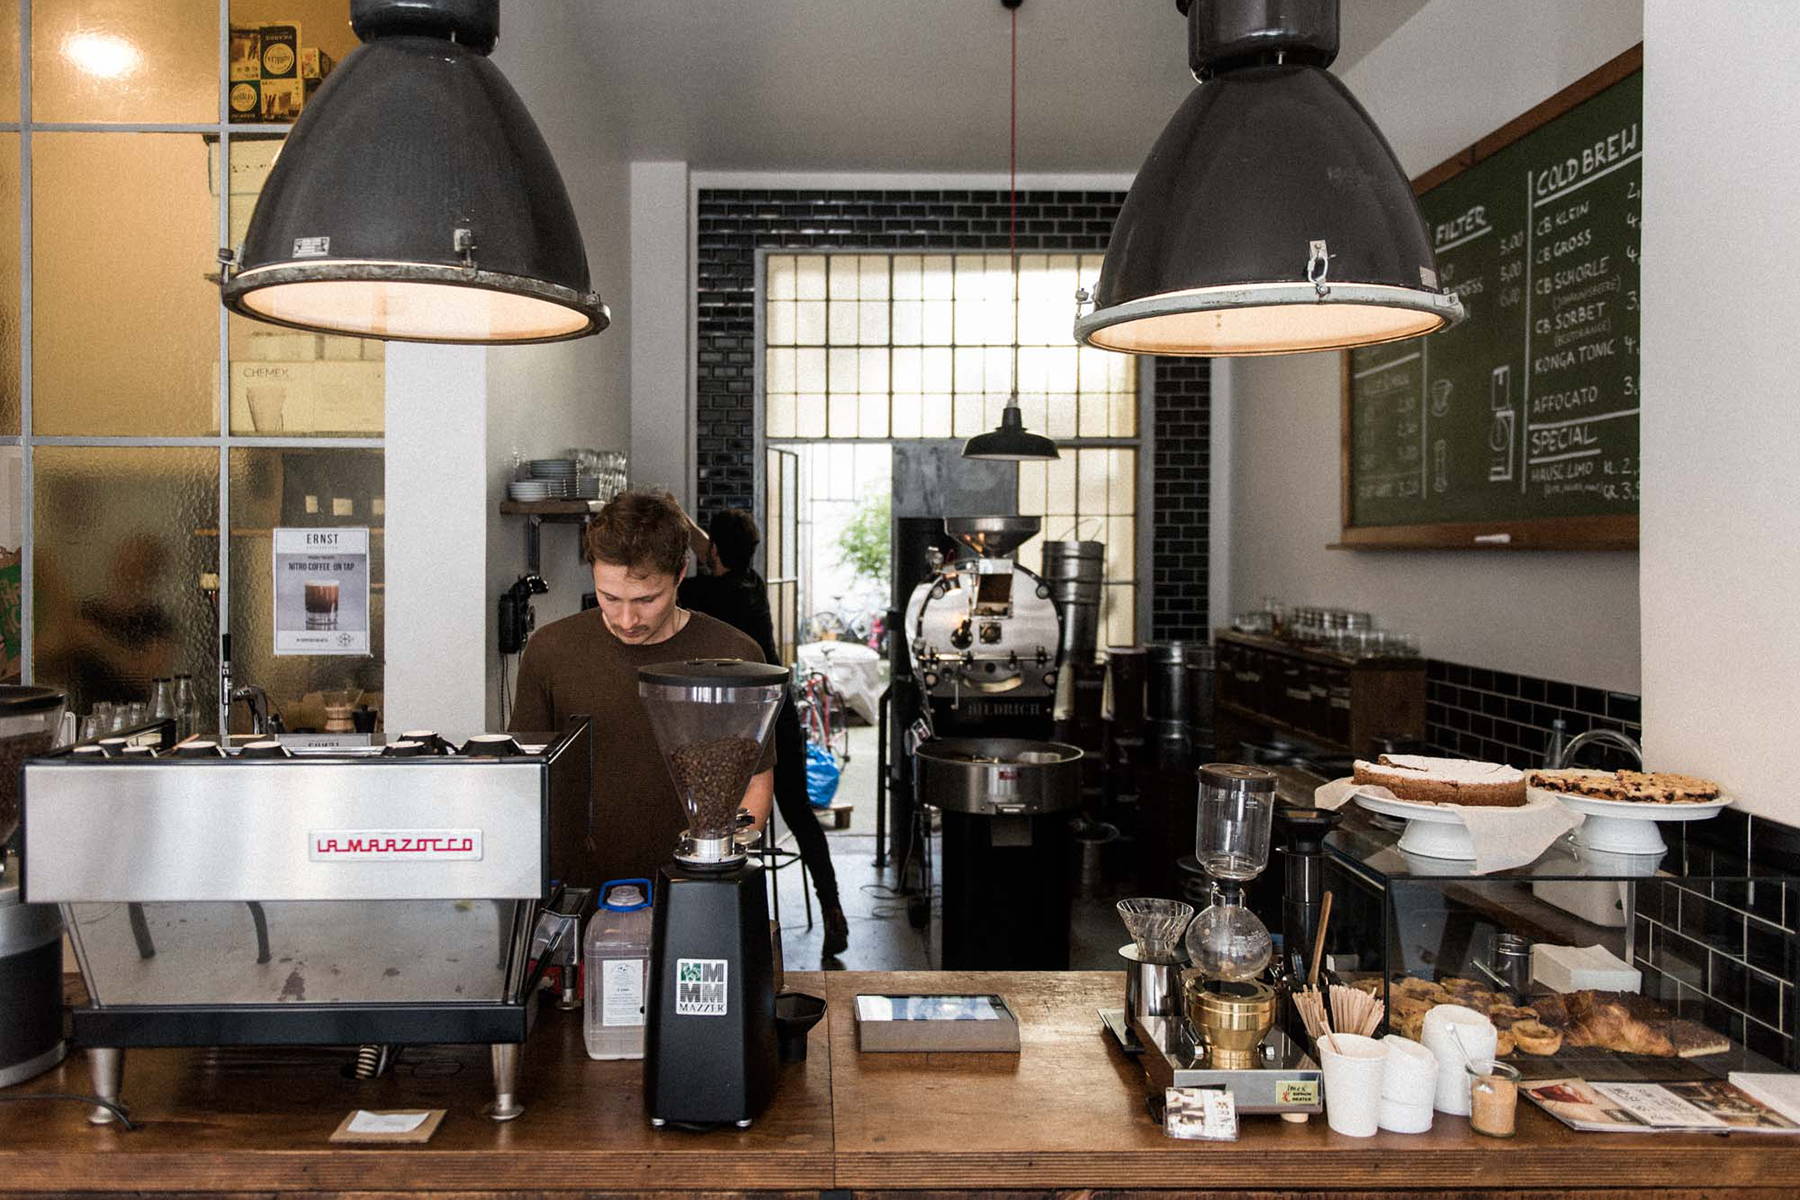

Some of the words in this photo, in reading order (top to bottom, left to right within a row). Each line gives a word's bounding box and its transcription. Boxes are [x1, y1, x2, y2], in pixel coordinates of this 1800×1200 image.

[1536, 158, 1578, 195] COLD
[1582, 123, 1637, 175] BREW
[1436, 205, 1487, 245] FILTER
[1537, 216, 1552, 236] CB
[1556, 200, 1590, 225] KLEIN
[1537, 246, 1551, 264] CB
[1554, 228, 1592, 257] GROSS
[1535, 277, 1552, 295] CB
[1554, 256, 1610, 289] SCHORLE
[1535, 318, 1551, 334] CB
[1555, 301, 1606, 330] SORBET
[1535, 351, 1576, 374] KONGA
[1578, 338, 1616, 363] TONIC
[1531, 424, 1599, 455] SPECIAL
[1565, 461, 1594, 479] LIMO
[306, 533, 339, 545] ERNST
[288, 562, 308, 571] NITRO
[308, 562, 330, 571] COFFEE
[333, 562, 342, 571] ON
[343, 562, 355, 571] TAP
[679, 1003, 724, 1012] MAZZER
